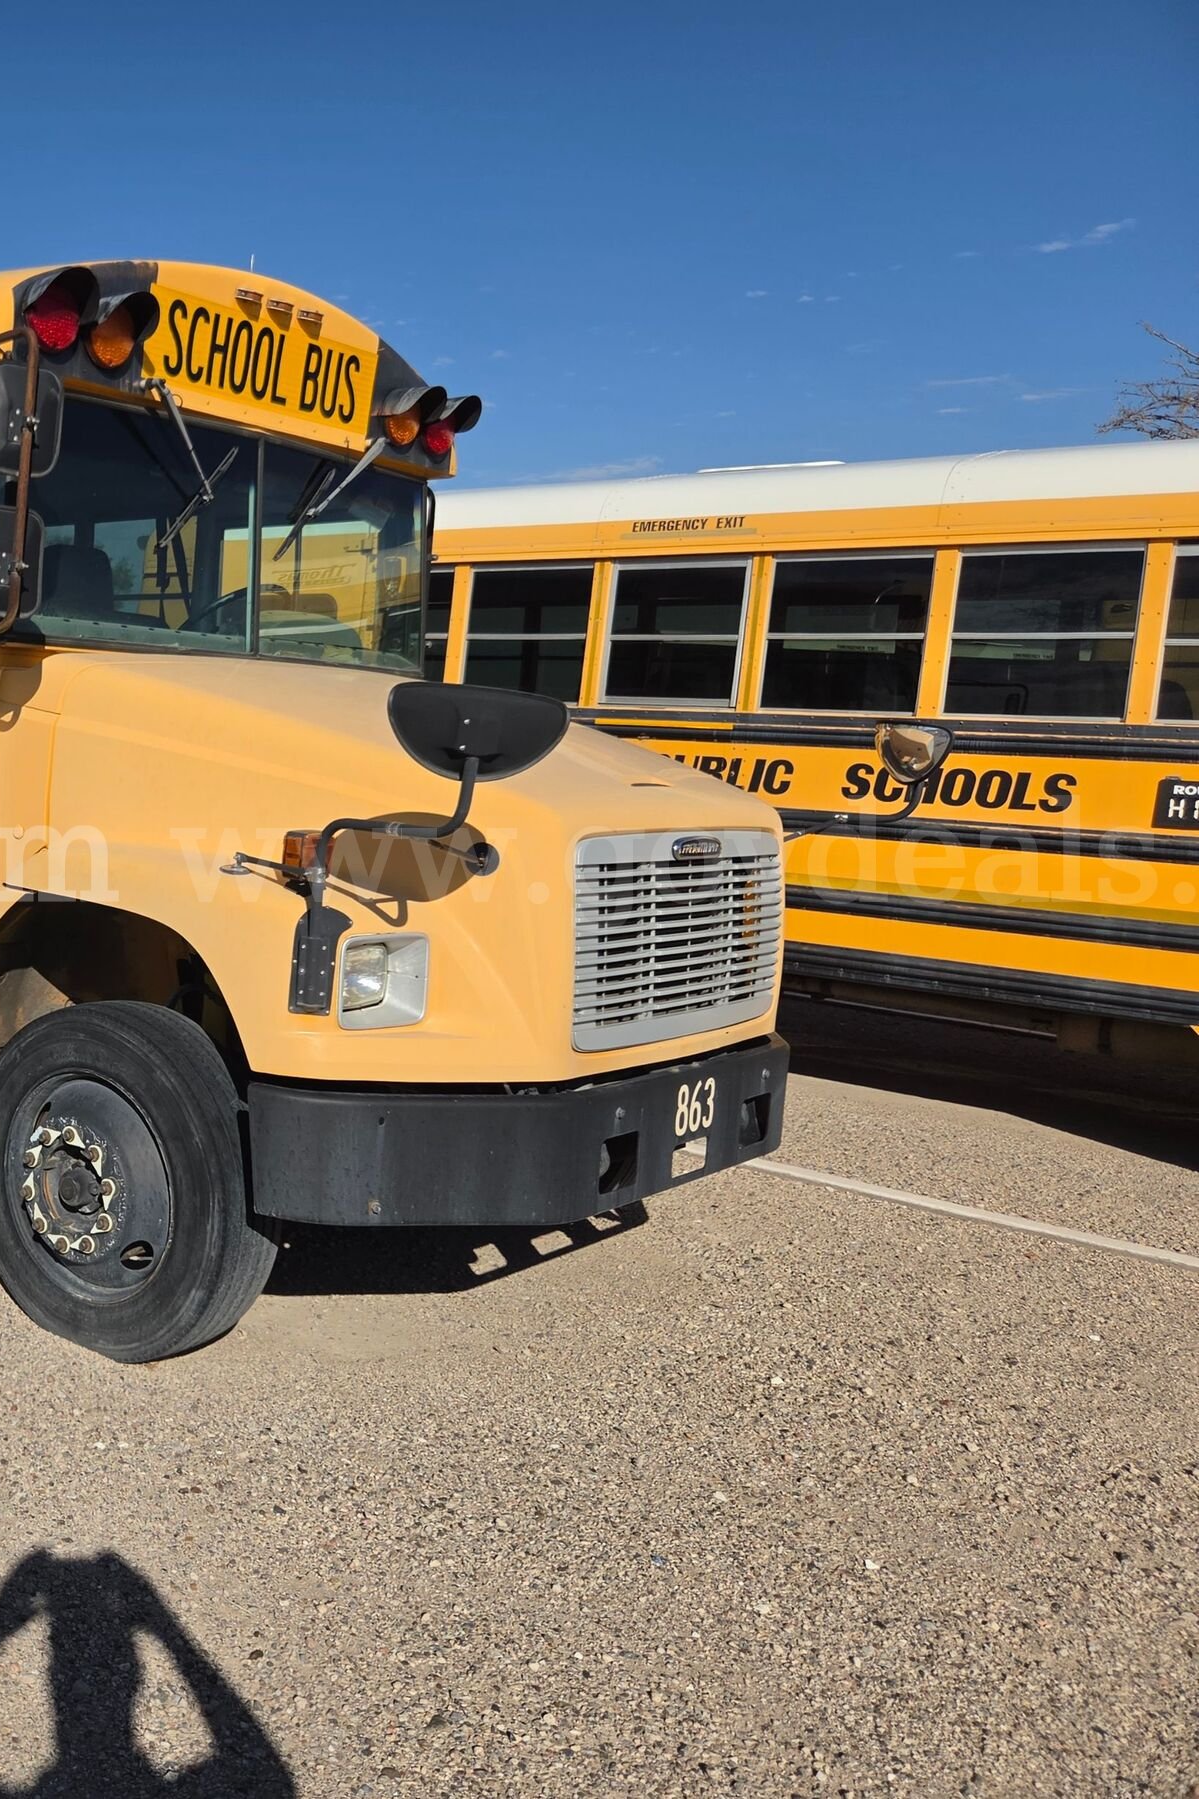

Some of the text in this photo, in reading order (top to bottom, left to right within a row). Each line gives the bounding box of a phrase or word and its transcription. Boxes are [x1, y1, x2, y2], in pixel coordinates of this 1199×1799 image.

[163, 299, 360, 424] SCHOOL BUS
[632, 516, 746, 533] EMERGENCY EXIT
[1172, 784, 1199, 796] RO
[675, 1077, 716, 1137] 863
